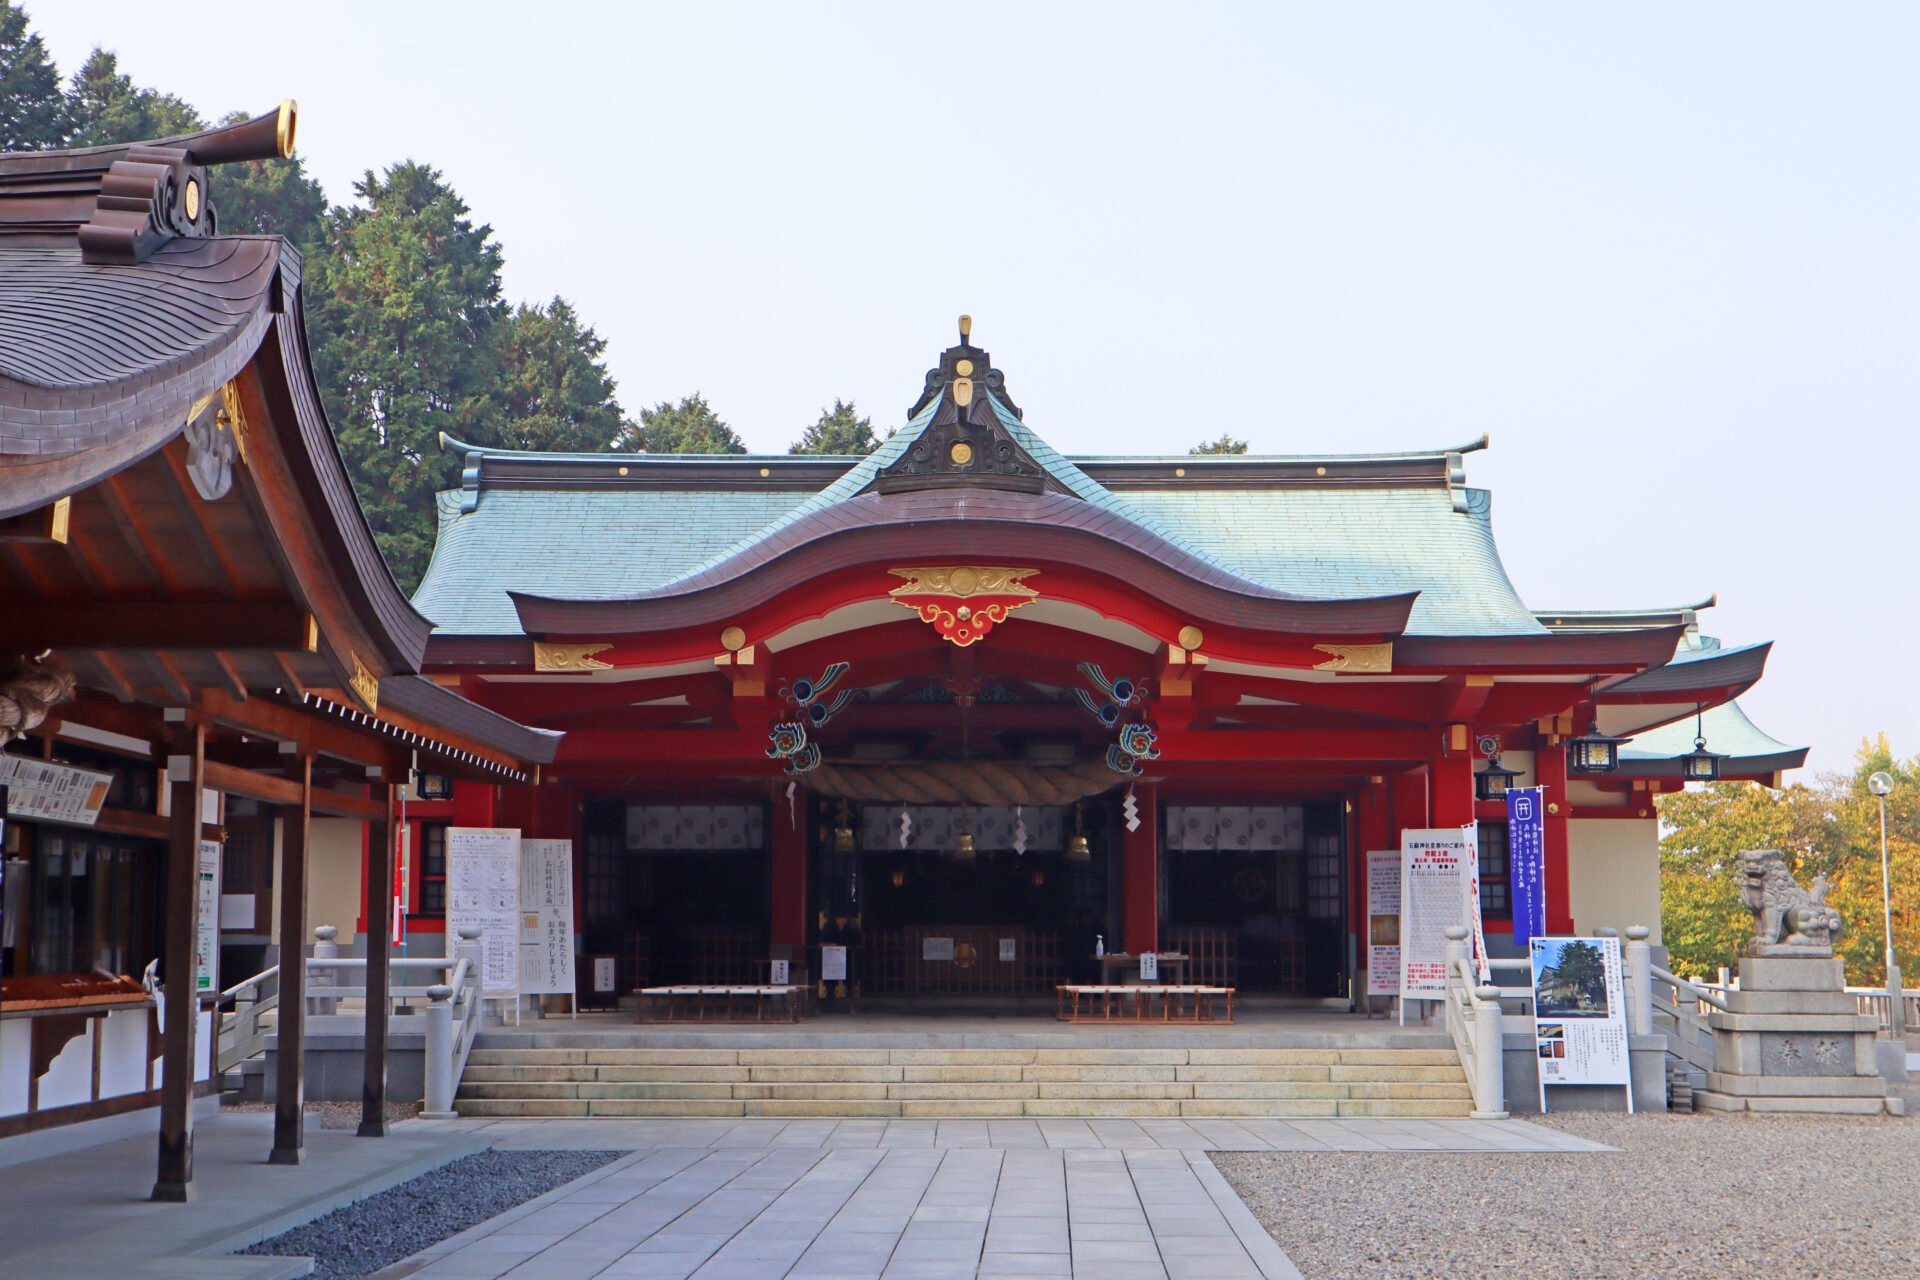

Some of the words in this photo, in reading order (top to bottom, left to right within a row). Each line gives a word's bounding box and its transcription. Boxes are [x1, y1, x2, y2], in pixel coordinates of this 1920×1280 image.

[547, 921, 557, 987] おまつりしましょう
[558, 921, 567, 975] 毎年あたらしく
